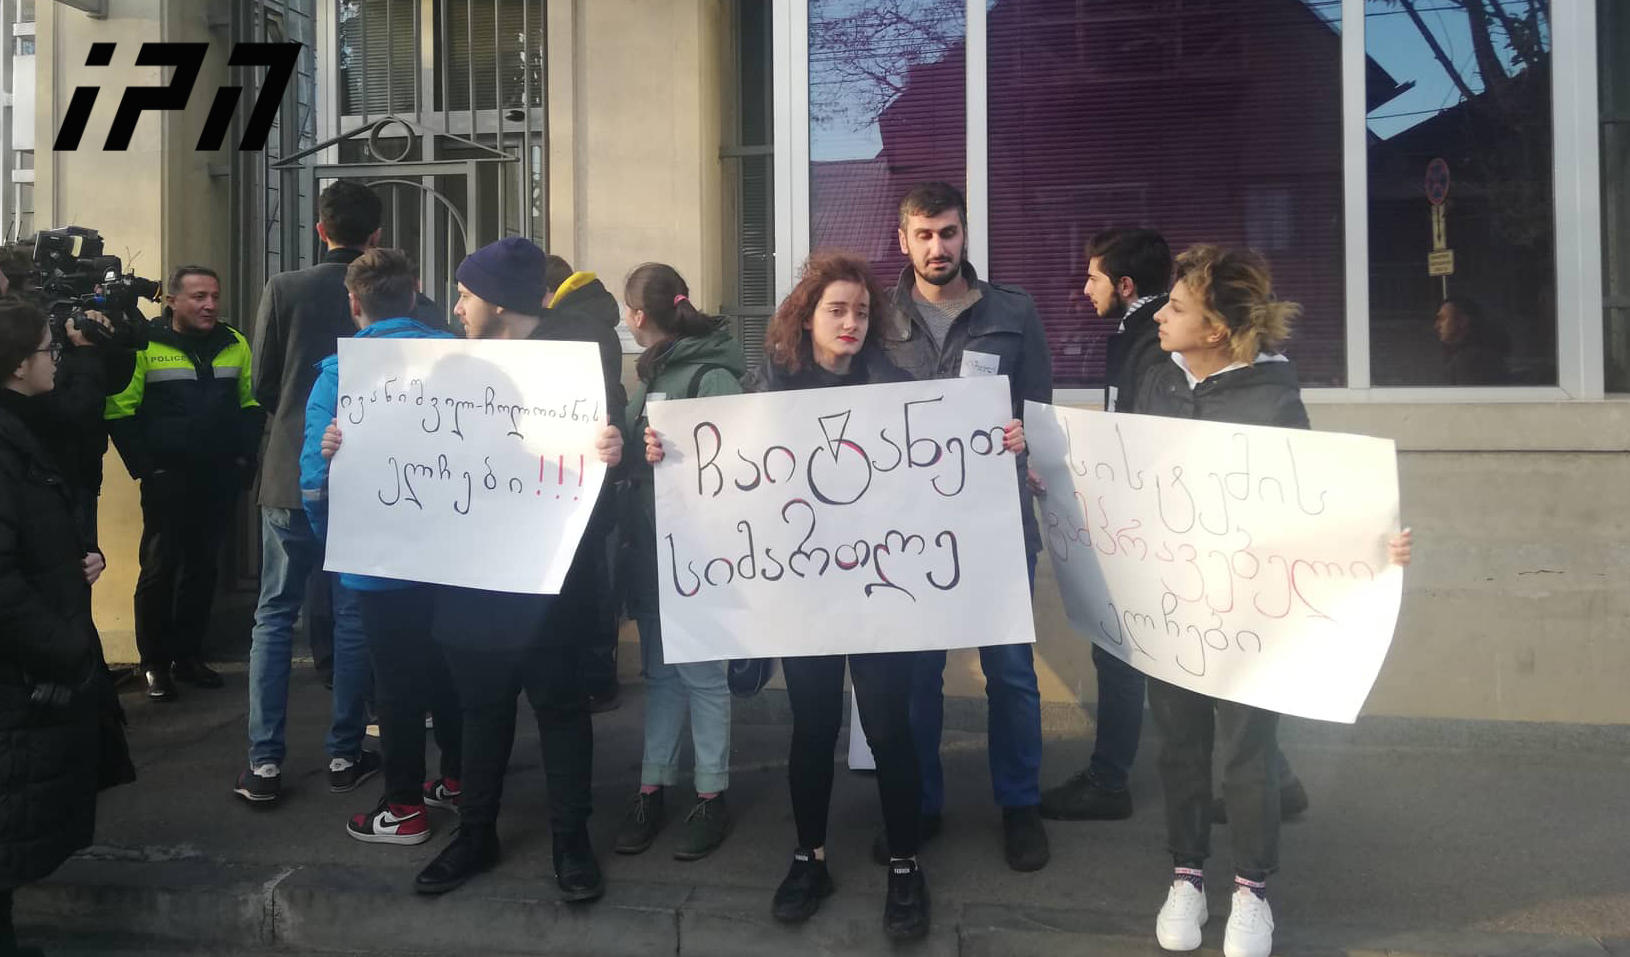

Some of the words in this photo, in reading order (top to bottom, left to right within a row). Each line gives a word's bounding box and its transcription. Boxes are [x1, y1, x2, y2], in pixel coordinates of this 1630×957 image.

[1064, 416, 1327, 535] სისტემის
[665, 498, 960, 602] სიმართლე
[1100, 591, 1262, 677] ელჩები
